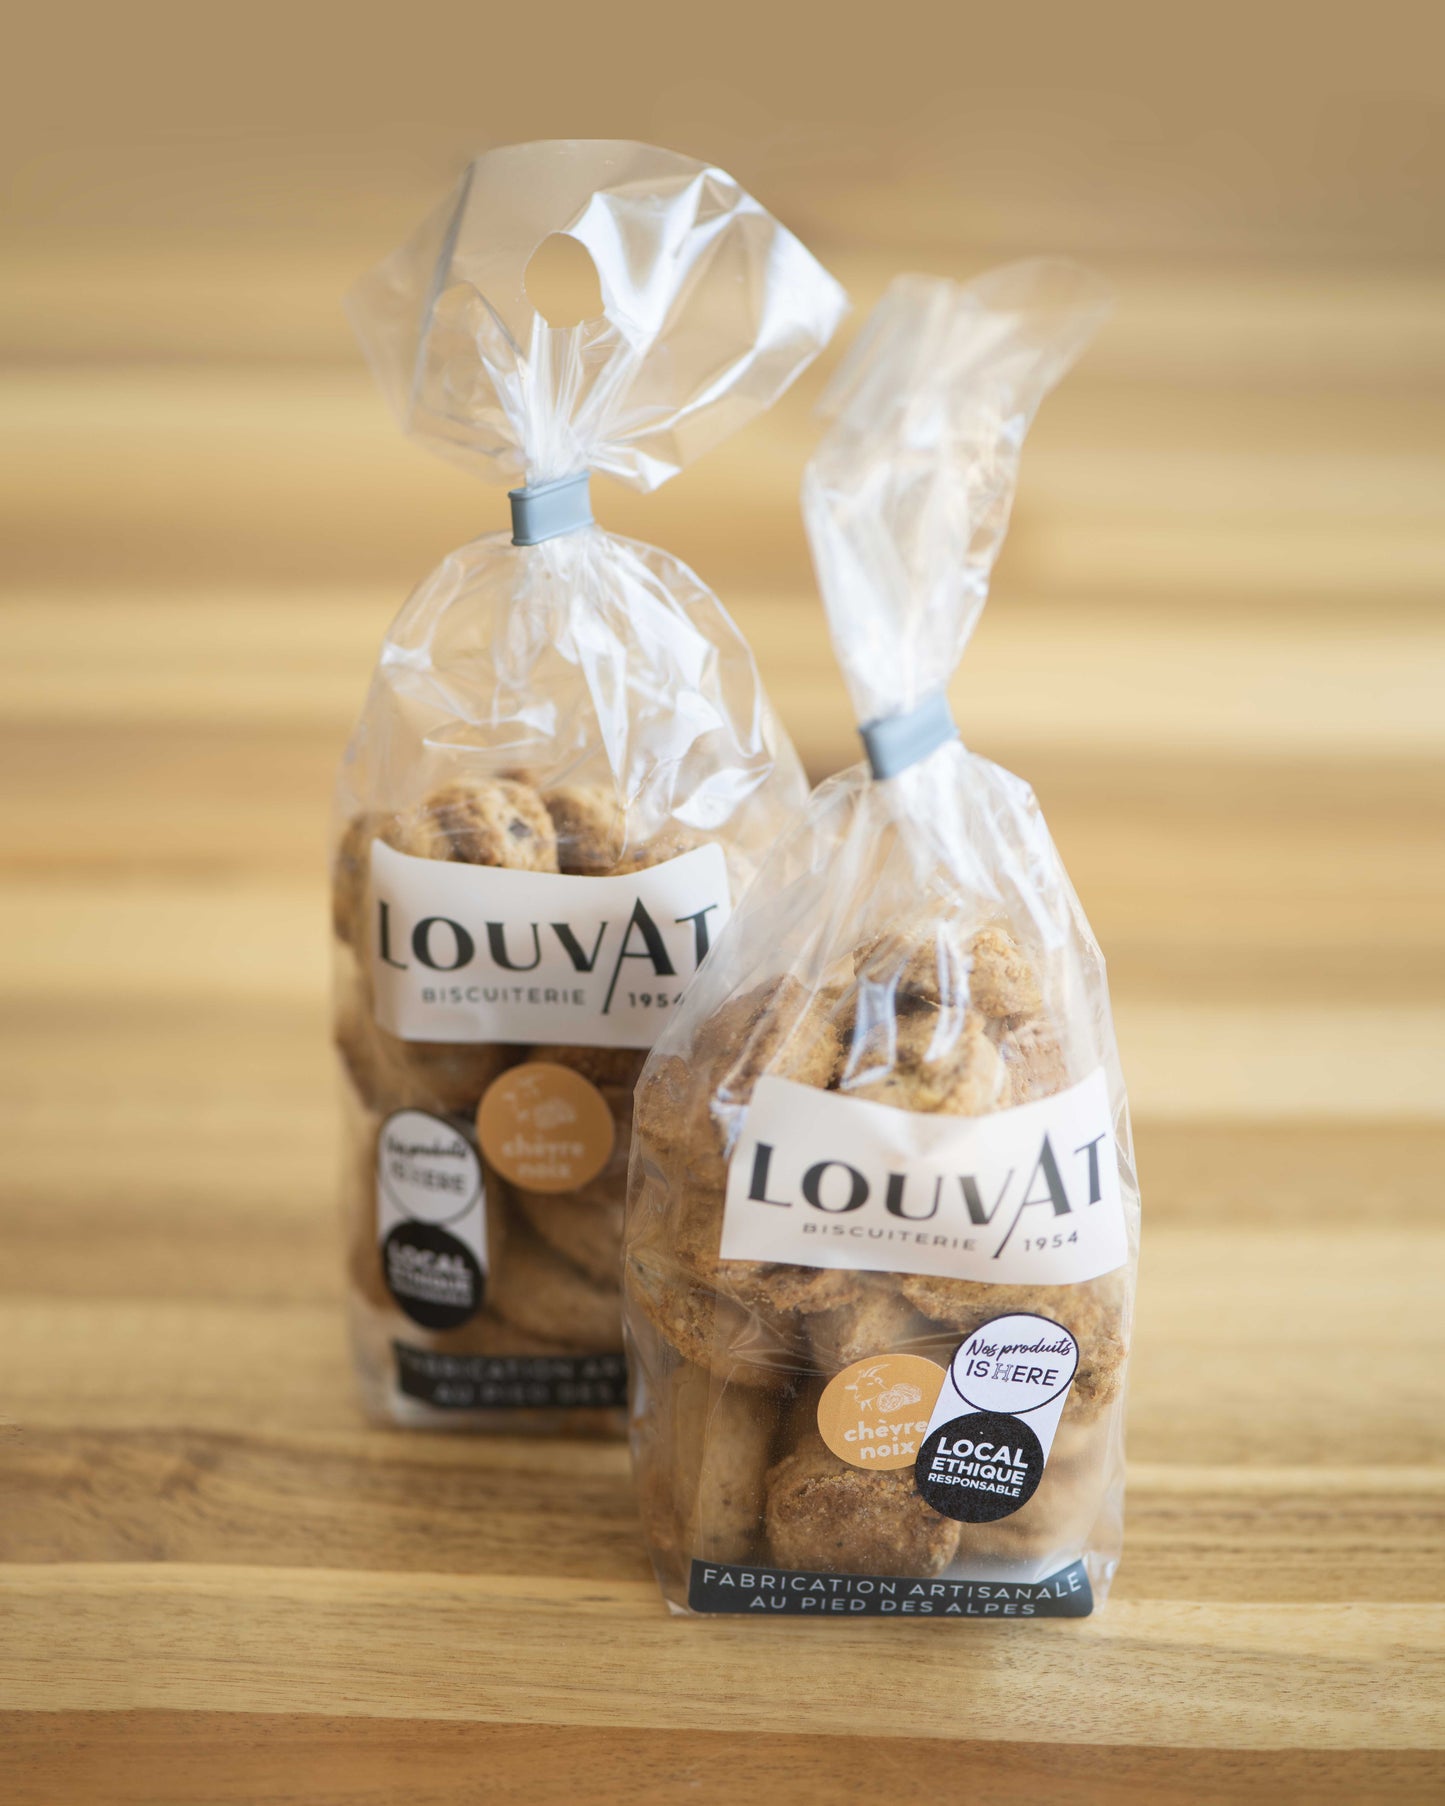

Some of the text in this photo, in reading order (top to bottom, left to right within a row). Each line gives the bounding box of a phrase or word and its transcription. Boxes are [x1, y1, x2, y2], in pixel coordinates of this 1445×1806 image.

[421, 986, 587, 1006] BISCUITERIE
[748, 1130, 1106, 1259] LOUVAT
[802, 1223, 1080, 1252] BISCUITERIE 1954
[965, 1337, 1075, 1361] Nos produits
[844, 1419, 928, 1442] chèvre
[860, 1437, 916, 1460] noix
[936, 1436, 1029, 1469] LOCAL
[931, 1456, 1026, 1486] ETHIQUE
[927, 1472, 1022, 1498] RESPONSABLE
[703, 1569, 1082, 1601] FABRICATION ARTISANALE
[750, 1595, 1036, 1616] AU PIED DES ALPES
